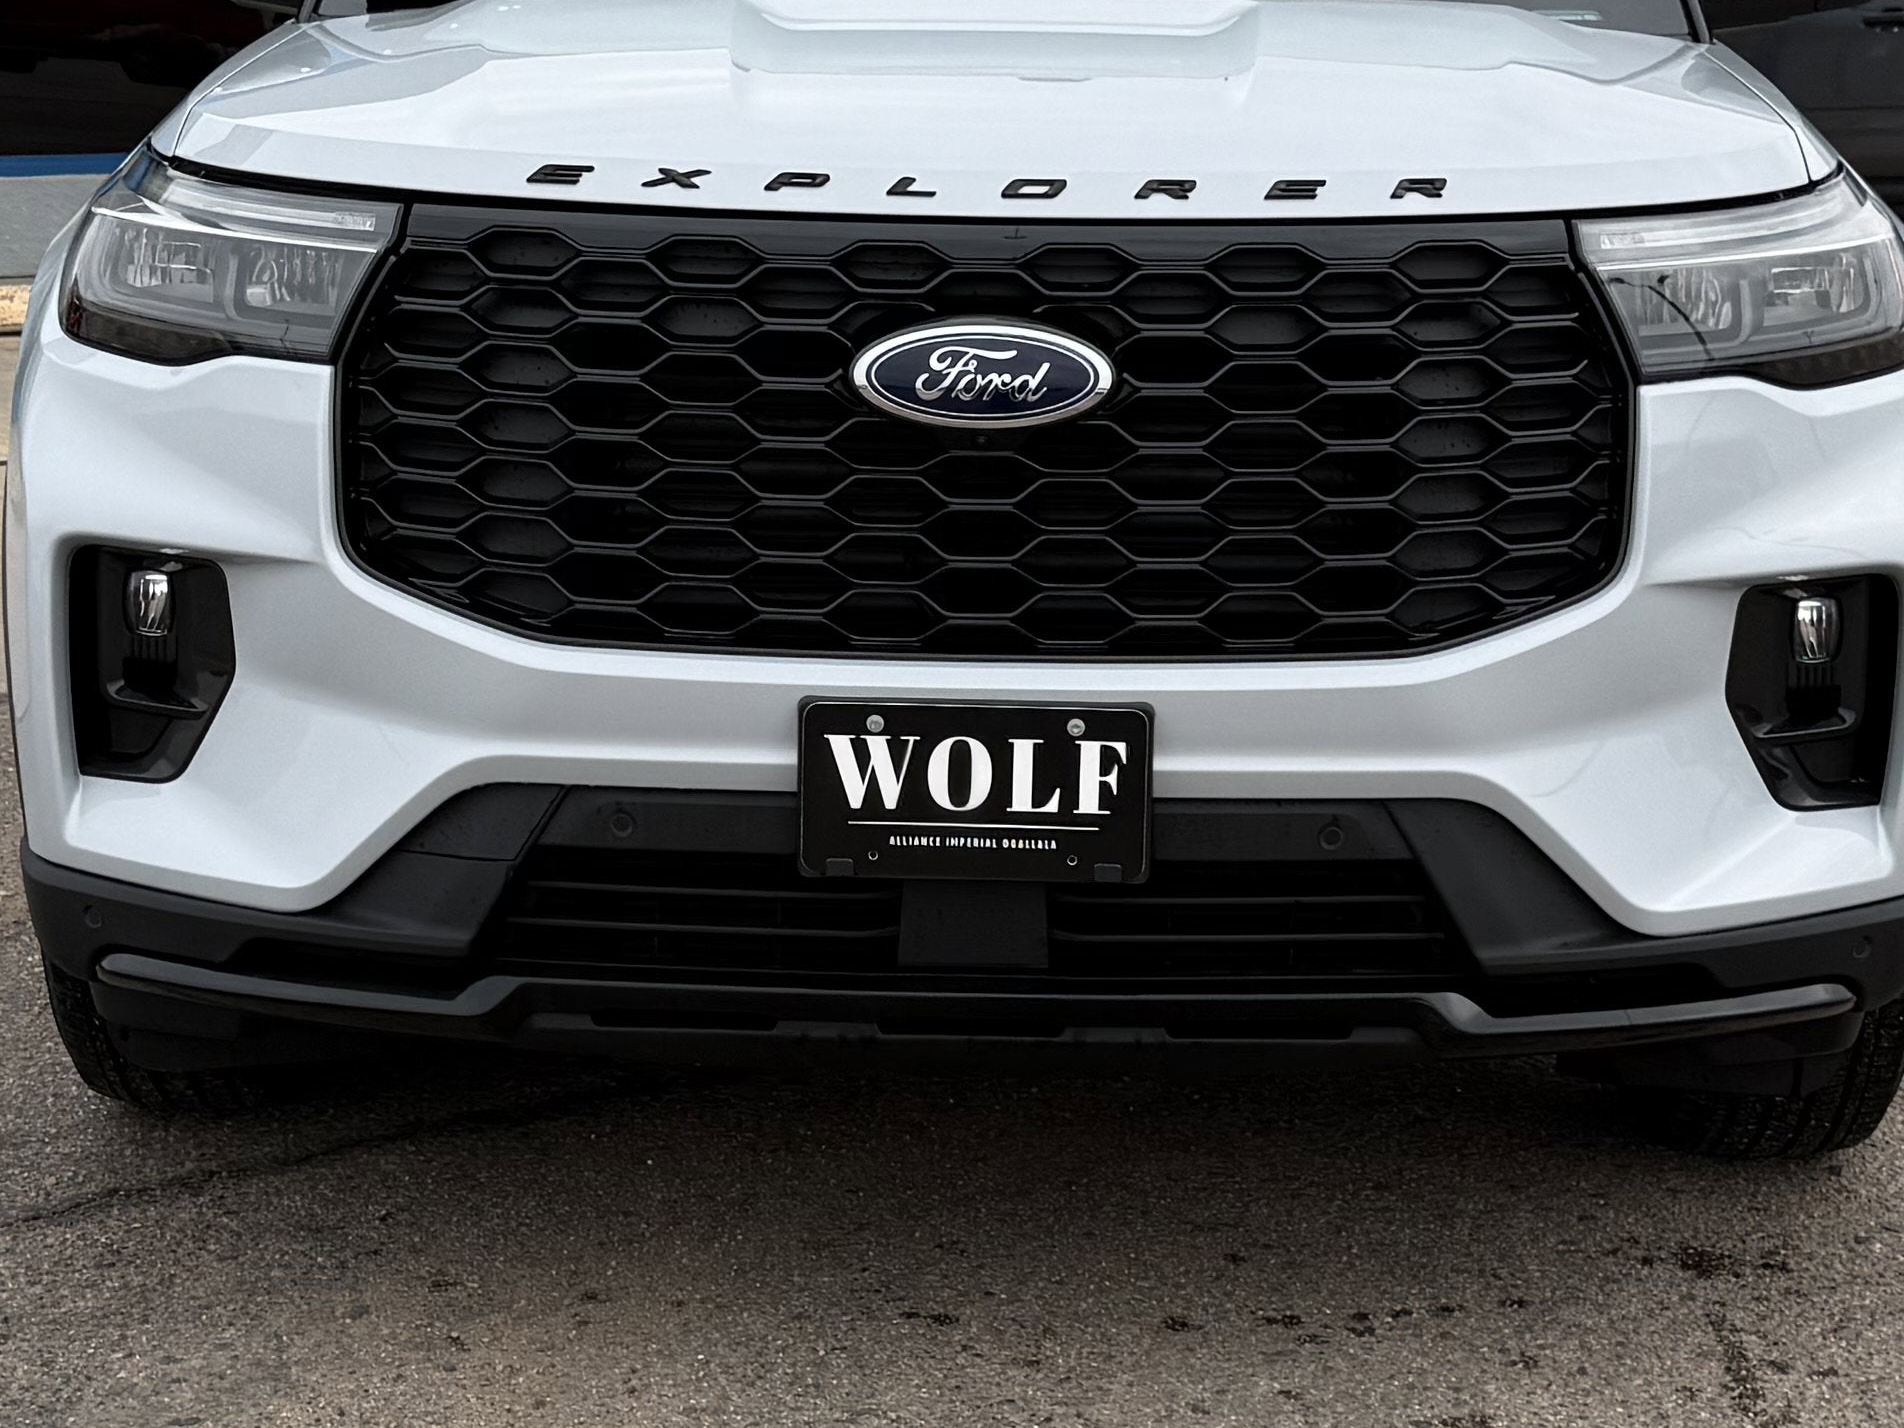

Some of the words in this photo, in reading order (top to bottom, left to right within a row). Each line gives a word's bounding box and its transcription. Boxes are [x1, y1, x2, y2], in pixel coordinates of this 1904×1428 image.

[526, 163, 1448, 201] EXPLORER
[915, 346, 1051, 402] Ford
[823, 734, 1128, 815] WOLF
